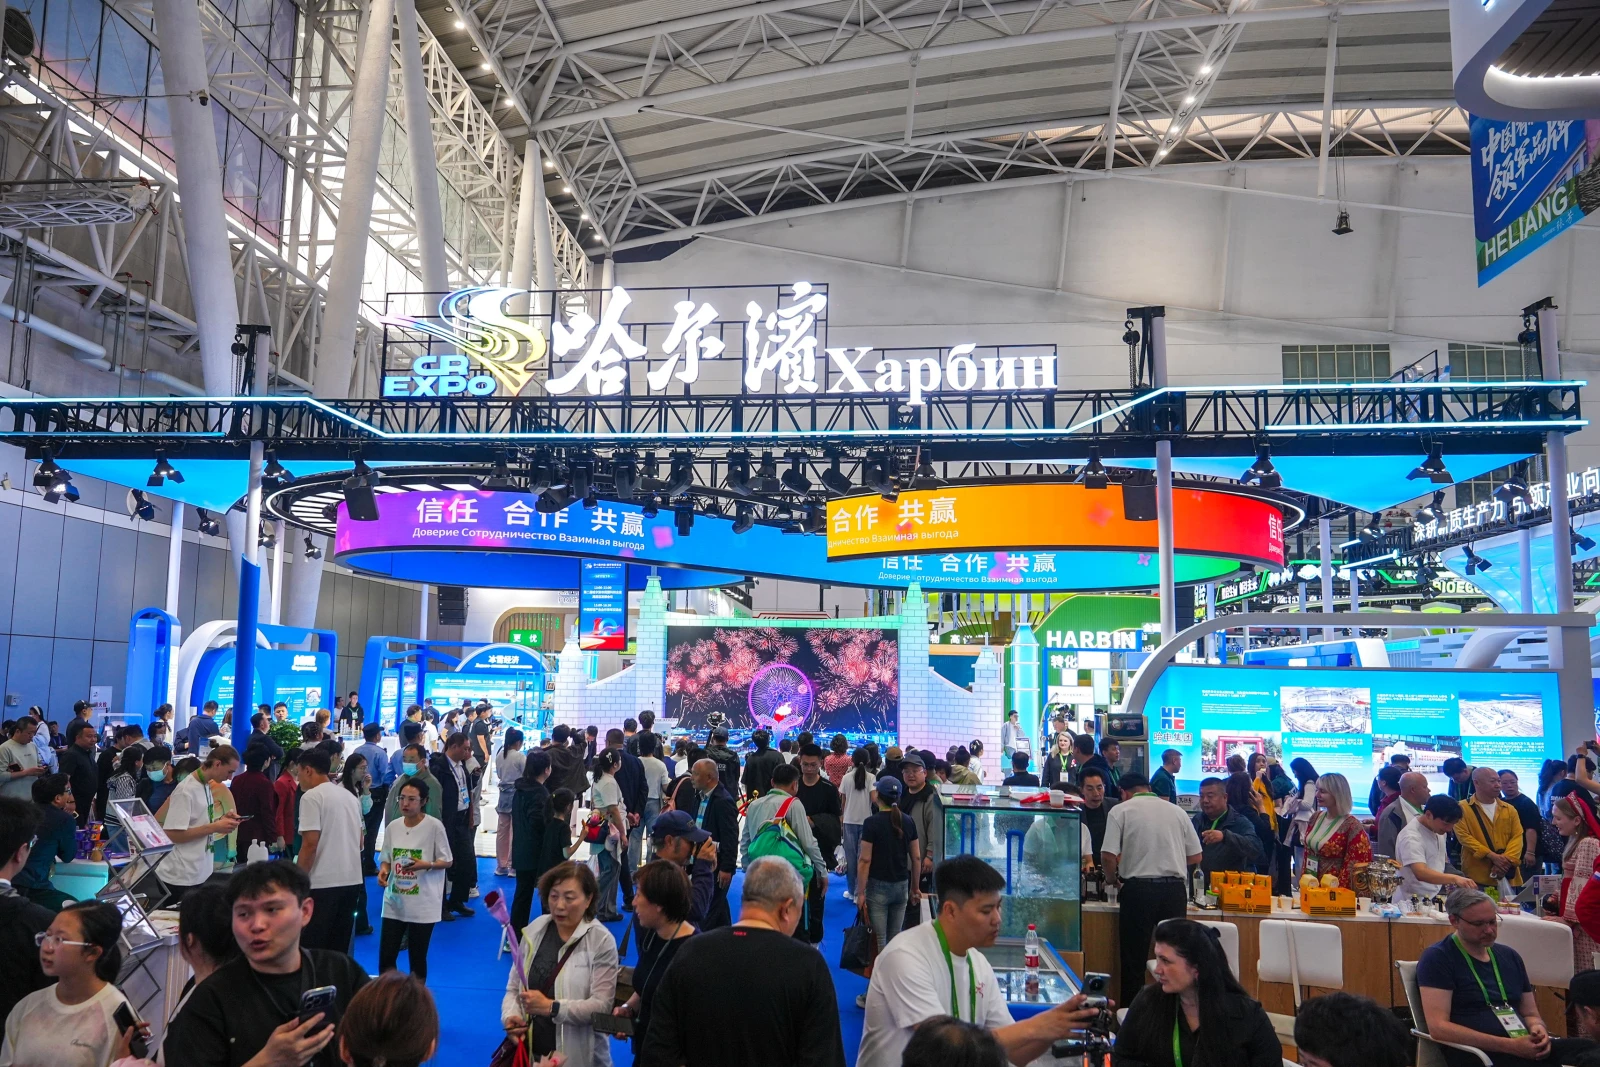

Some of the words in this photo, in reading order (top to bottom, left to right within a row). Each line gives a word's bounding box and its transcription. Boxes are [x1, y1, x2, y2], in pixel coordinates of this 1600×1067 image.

[1484, 186, 1568, 266] HELIANG
[413, 355, 470, 376] CR
[826, 343, 1057, 405] Харбин
[383, 375, 497, 396] EXPO
[416, 497, 479, 524] 信任
[503, 499, 569, 529] 合作
[591, 507, 645, 538] 共赢
[831, 504, 879, 534] 合作
[898, 496, 957, 527] 共赢
[1413, 497, 1504, 542] 深耕质生产力
[412, 527, 460, 538] Доверие
[461, 527, 557, 541] Сотрудничество
[559, 532, 611, 546] Взаимная
[612, 540, 645, 551] выгода
[872, 531, 918, 543] Взаимная
[921, 529, 959, 540] выгода
[939, 553, 988, 573] 合作
[1006, 553, 1057, 573] 共赢
[878, 571, 911, 581] Доверие
[913, 575, 979, 583] отрудничество
[981, 575, 1024, 583] Взаимная
[1026, 576, 1058, 584] выгода
[1046, 630, 1137, 649] HARBIN
